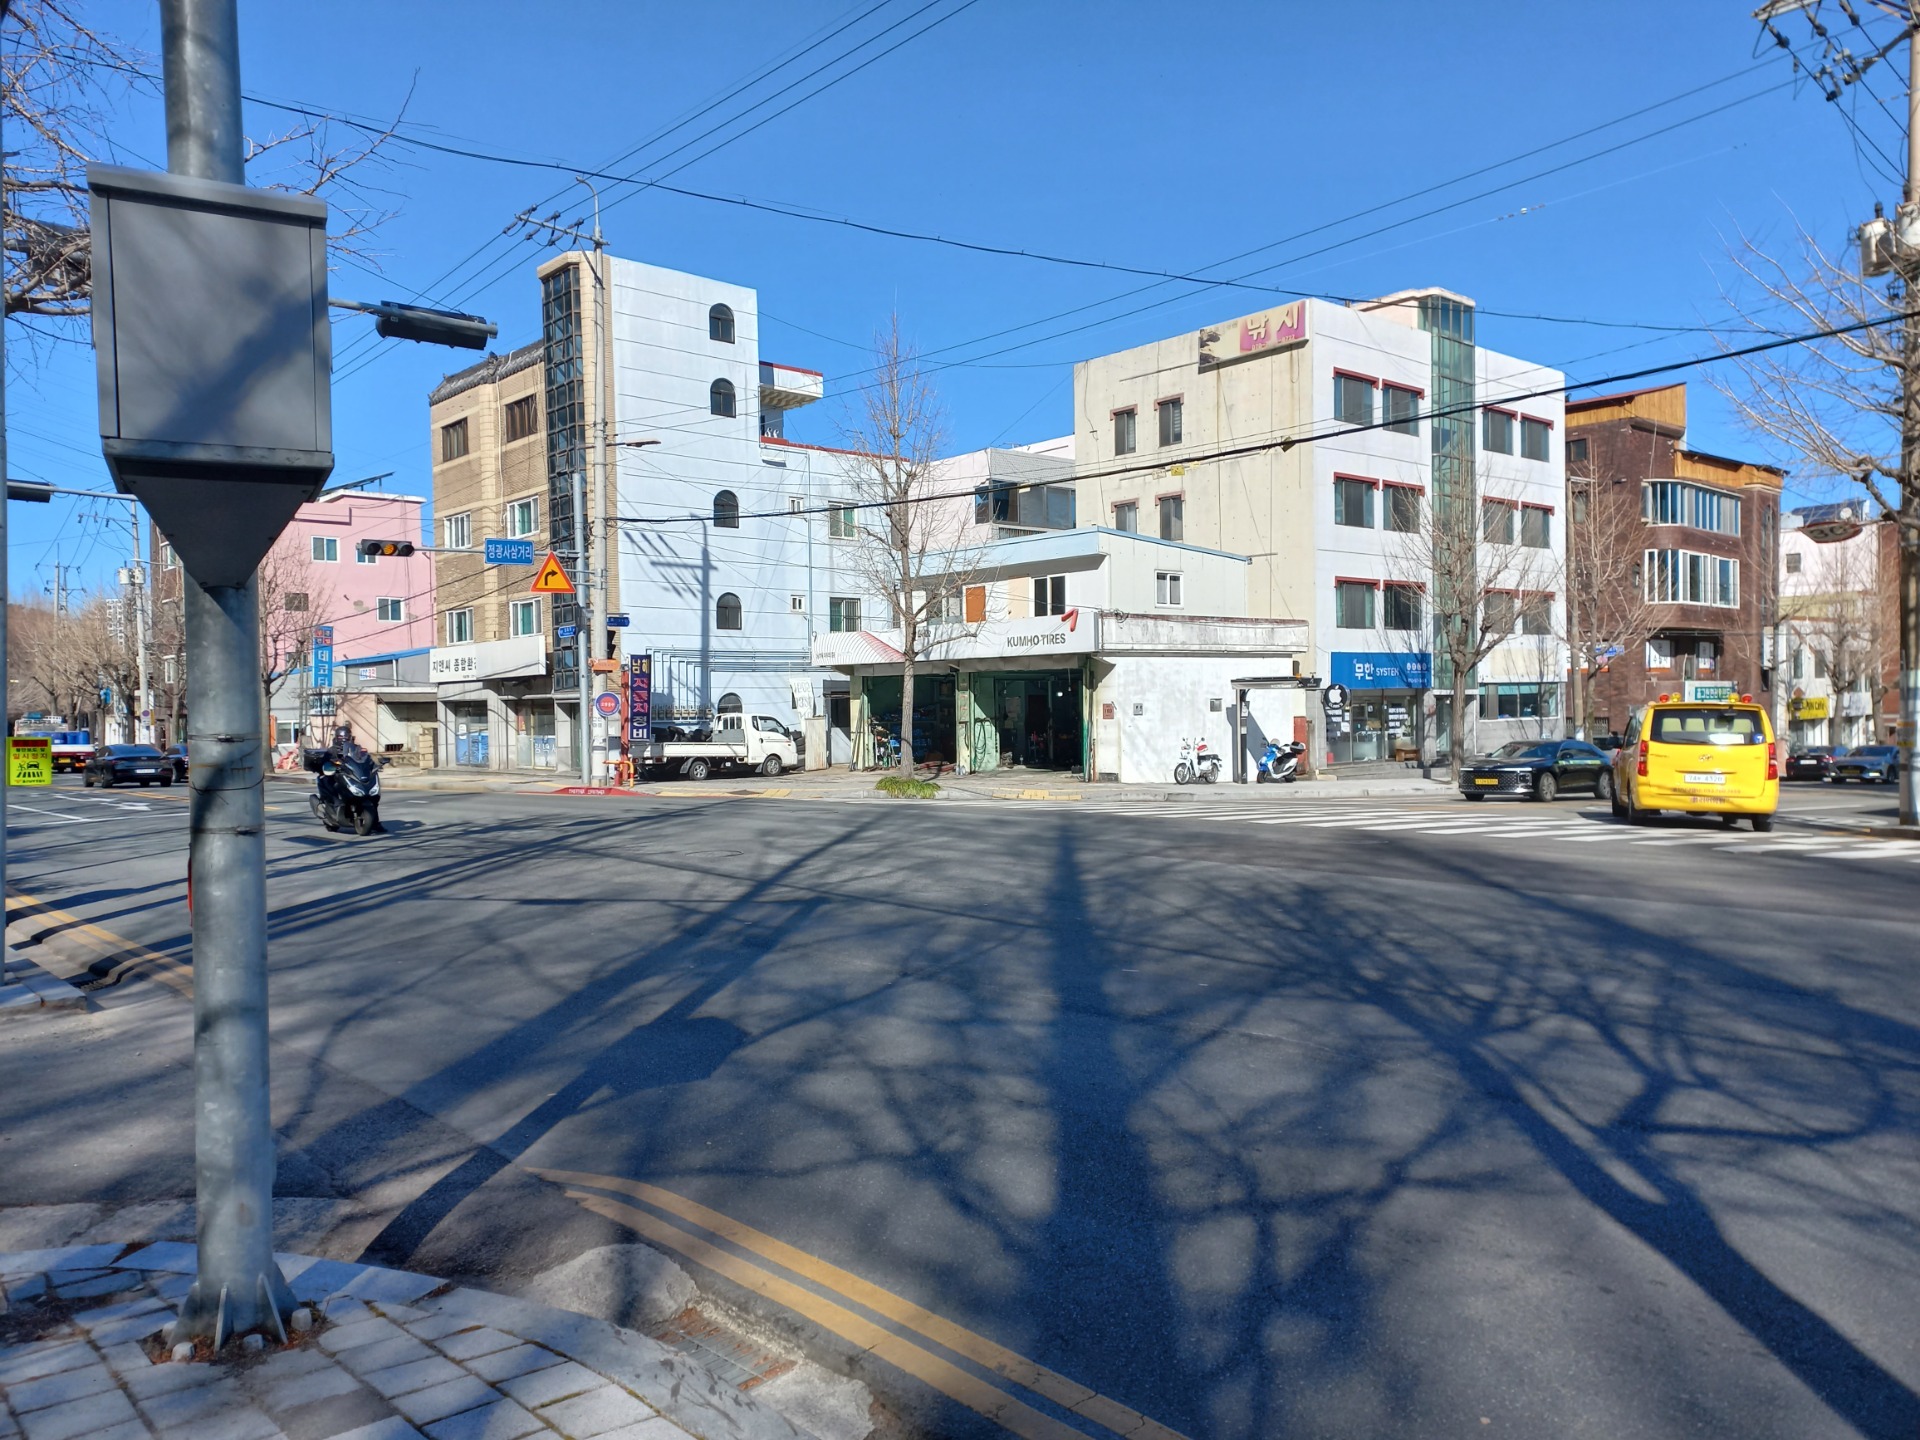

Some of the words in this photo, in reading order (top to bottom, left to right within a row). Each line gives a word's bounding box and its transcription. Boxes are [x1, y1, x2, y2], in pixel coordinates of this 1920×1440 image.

[487, 543, 532, 560] 정광사삼거리
[1007, 634, 1040, 648] KUMHO
[1040, 633, 1066, 645] TIRES
[1354, 662, 1375, 681] 무한
